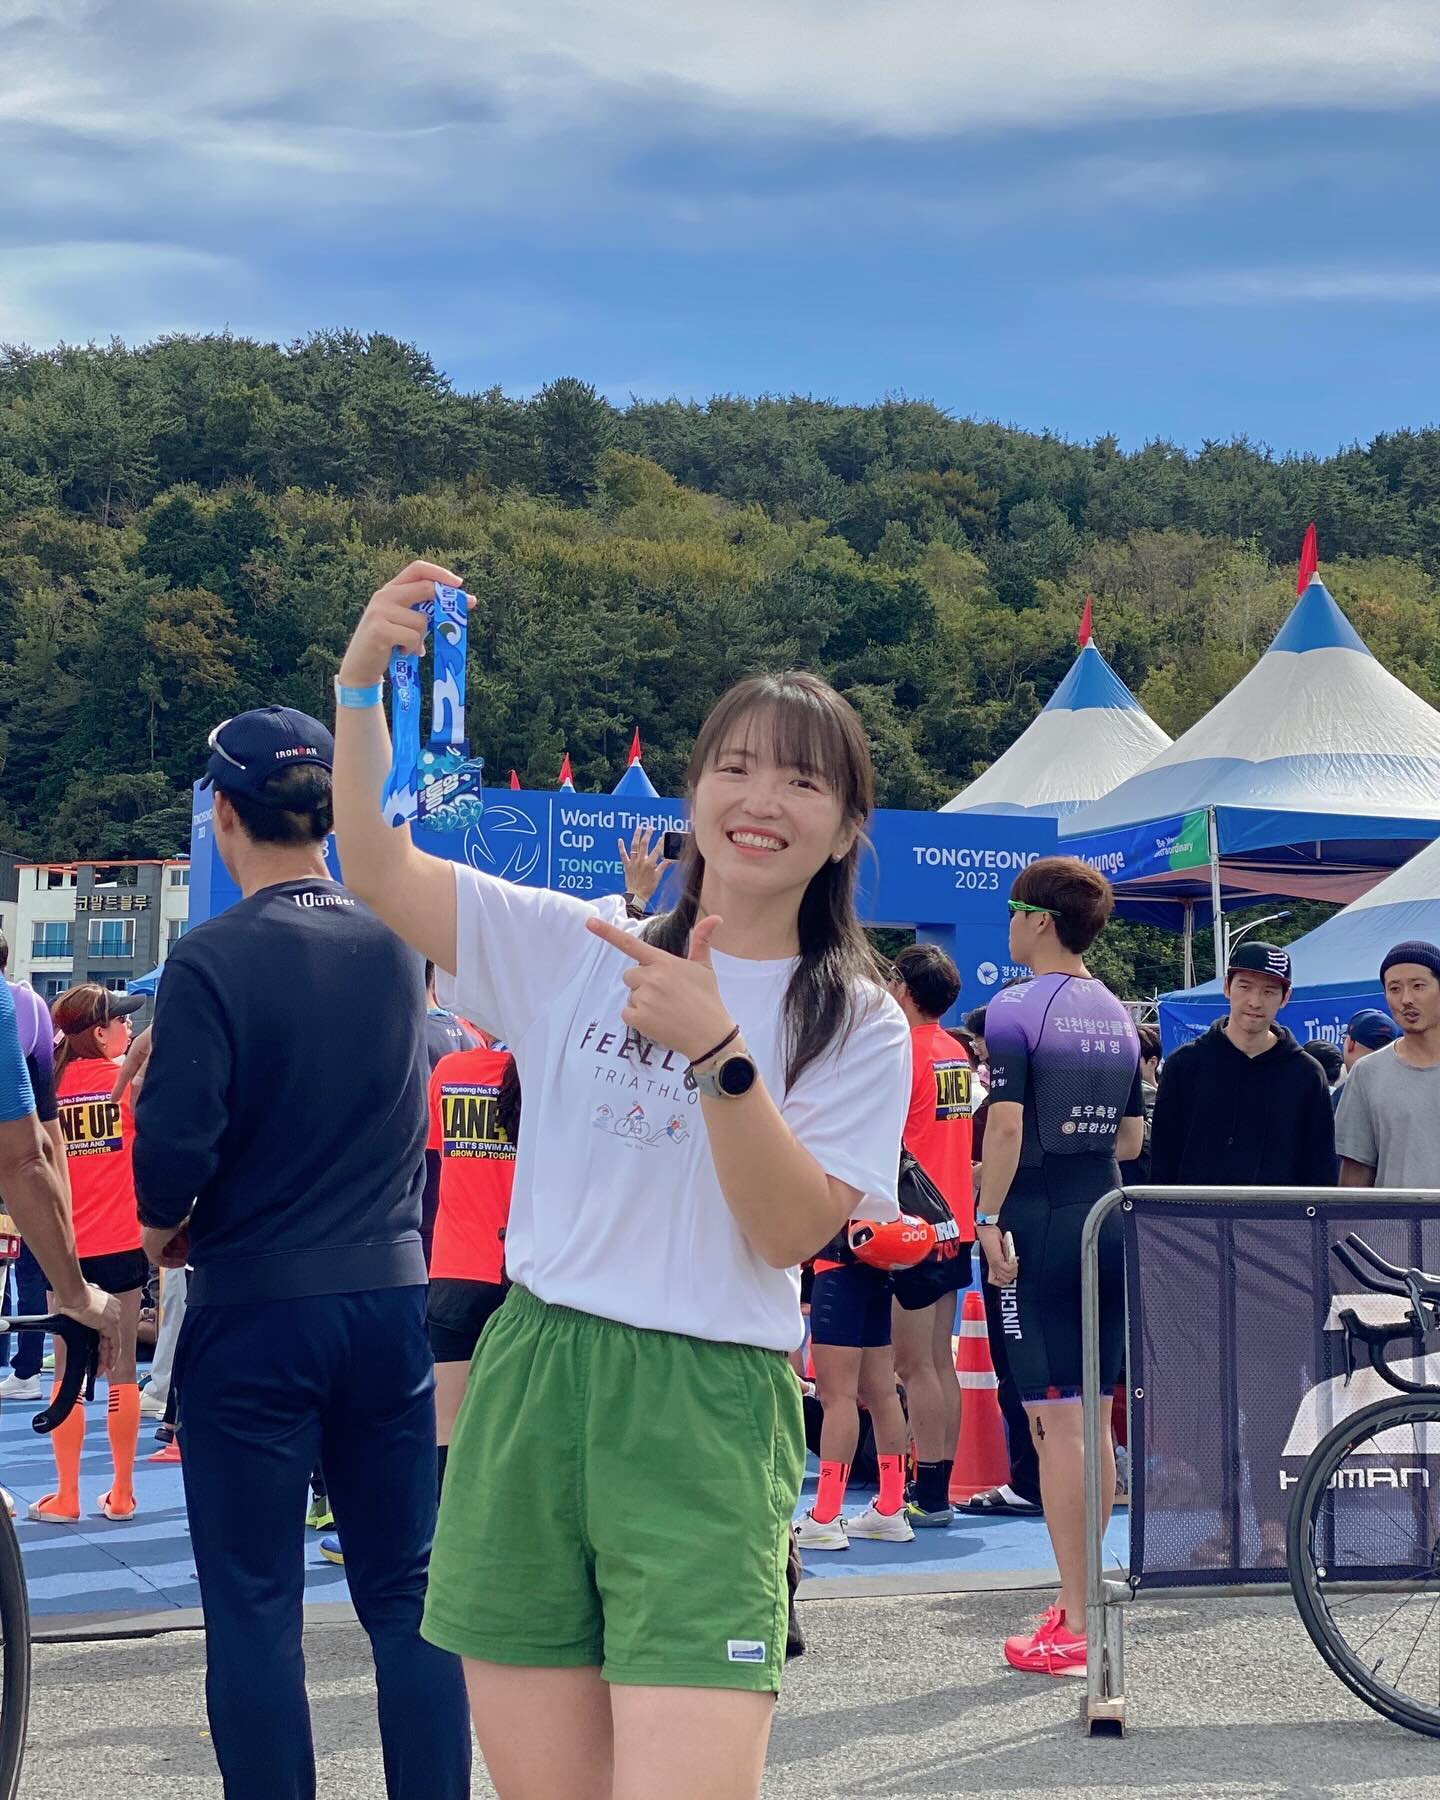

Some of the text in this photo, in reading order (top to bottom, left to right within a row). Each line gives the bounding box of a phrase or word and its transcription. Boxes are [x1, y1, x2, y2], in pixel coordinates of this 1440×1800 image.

[560, 808, 614, 828] World
[559, 830, 594, 852] Cup
[558, 858, 623, 874] TONGYE
[558, 875, 593, 890] 2023
[955, 871, 999, 890] 2023
[1304, 1016, 1346, 1045] Timi
[476, 1087, 492, 1095] No.1
[593, 1066, 698, 1105] TRIATHLO
[59, 1103, 120, 1141] NE UP
[89, 1140, 106, 1148] AND
[479, 1142, 502, 1151] SWIM
[502, 1143, 517, 1152] AN
[450, 1149, 516, 1161] GROW UP TOGHT
[1279, 1467, 1430, 1490] HMAN
